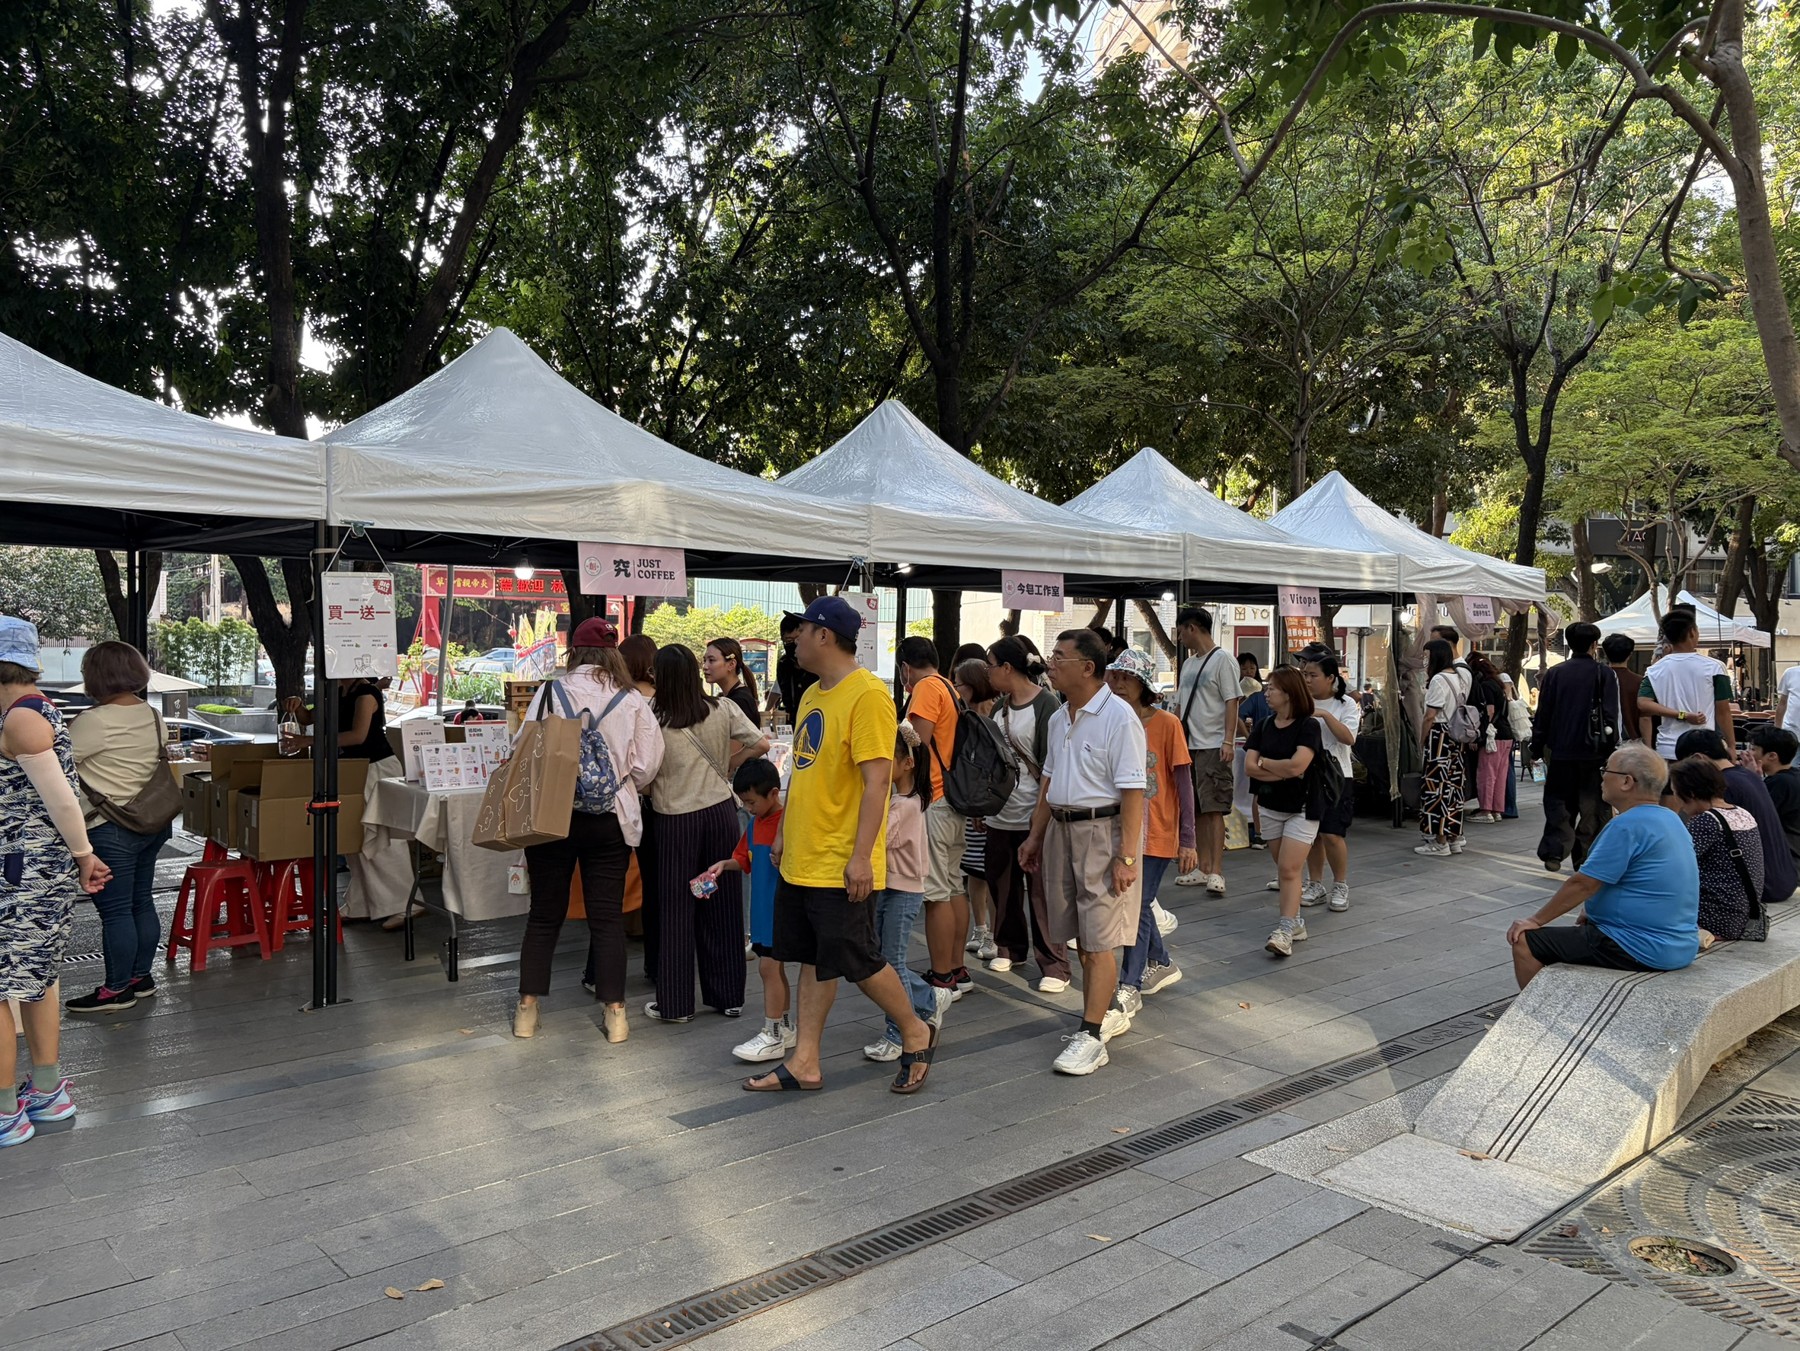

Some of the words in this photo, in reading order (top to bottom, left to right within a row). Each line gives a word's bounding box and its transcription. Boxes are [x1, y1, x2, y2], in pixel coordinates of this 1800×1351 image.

[613, 558, 631, 577] 究
[636, 559, 661, 568] JUST
[637, 570, 675, 580] COFFEE
[1017, 583, 1060, 597] 今皂工作室
[1289, 594, 1318, 606] Vitopa
[328, 605, 391, 620] 買一送一
